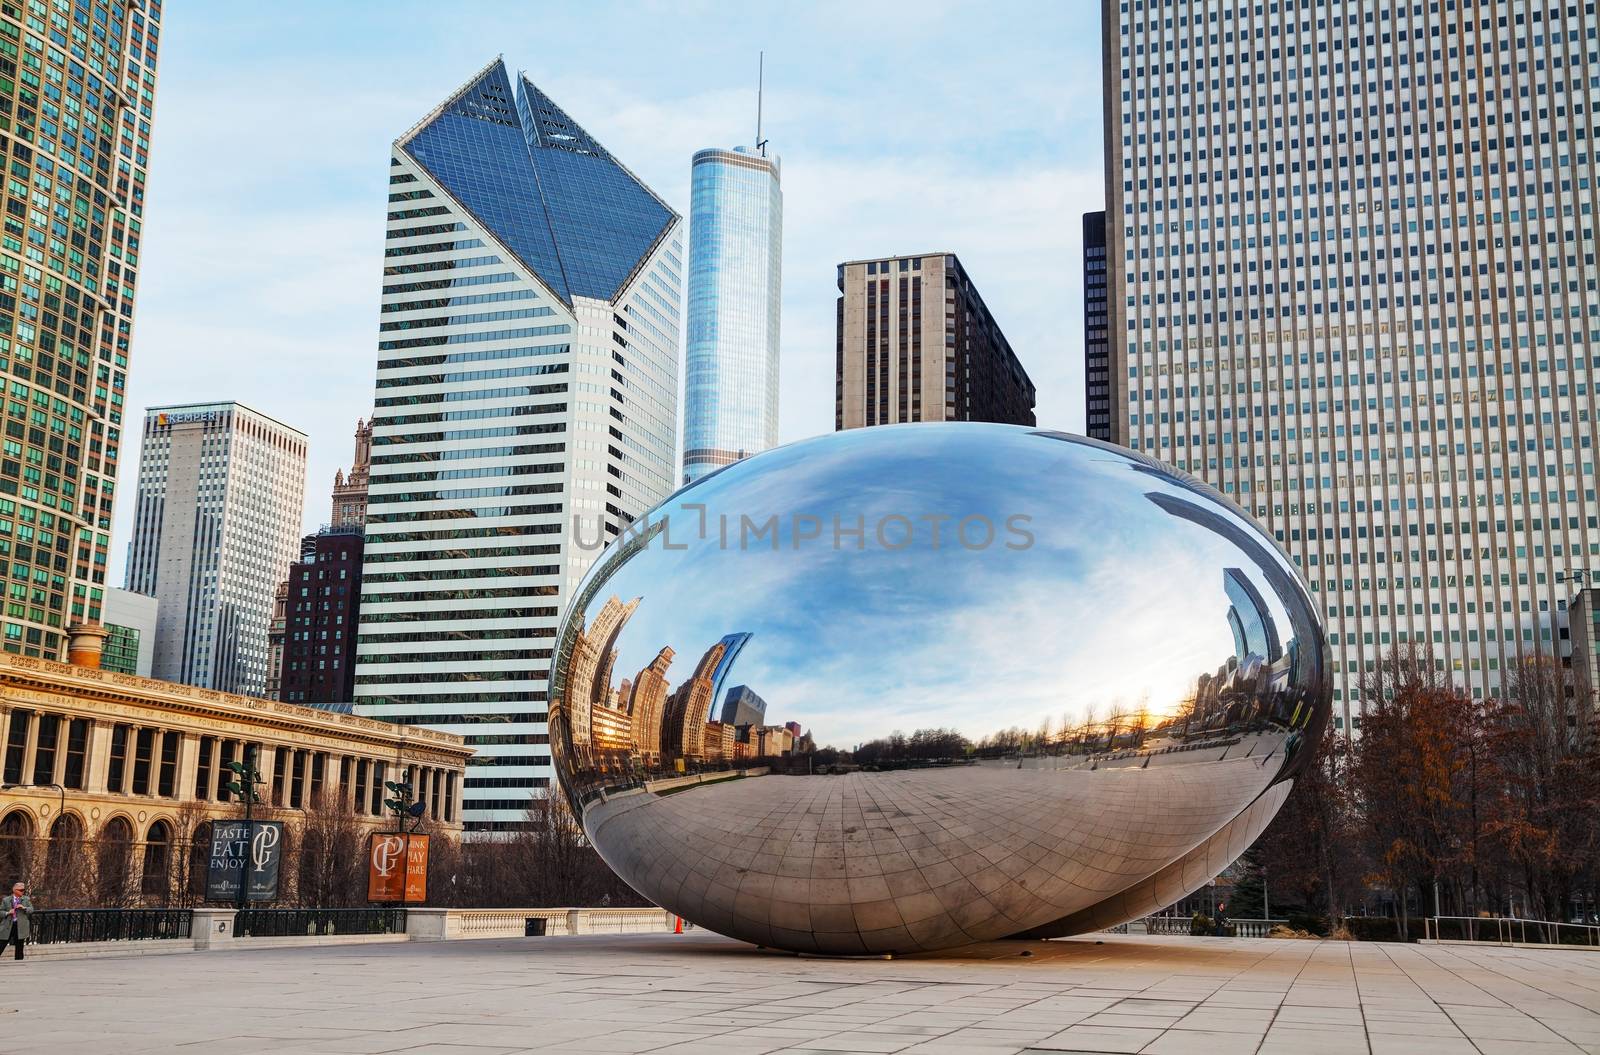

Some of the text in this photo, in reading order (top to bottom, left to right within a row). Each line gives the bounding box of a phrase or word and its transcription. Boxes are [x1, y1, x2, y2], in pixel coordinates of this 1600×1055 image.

[169, 412, 216, 424] KEMPER
[214, 828, 250, 839] TASTE
[212, 841, 249, 857] EAT
[210, 858, 247, 871] ENJOY
